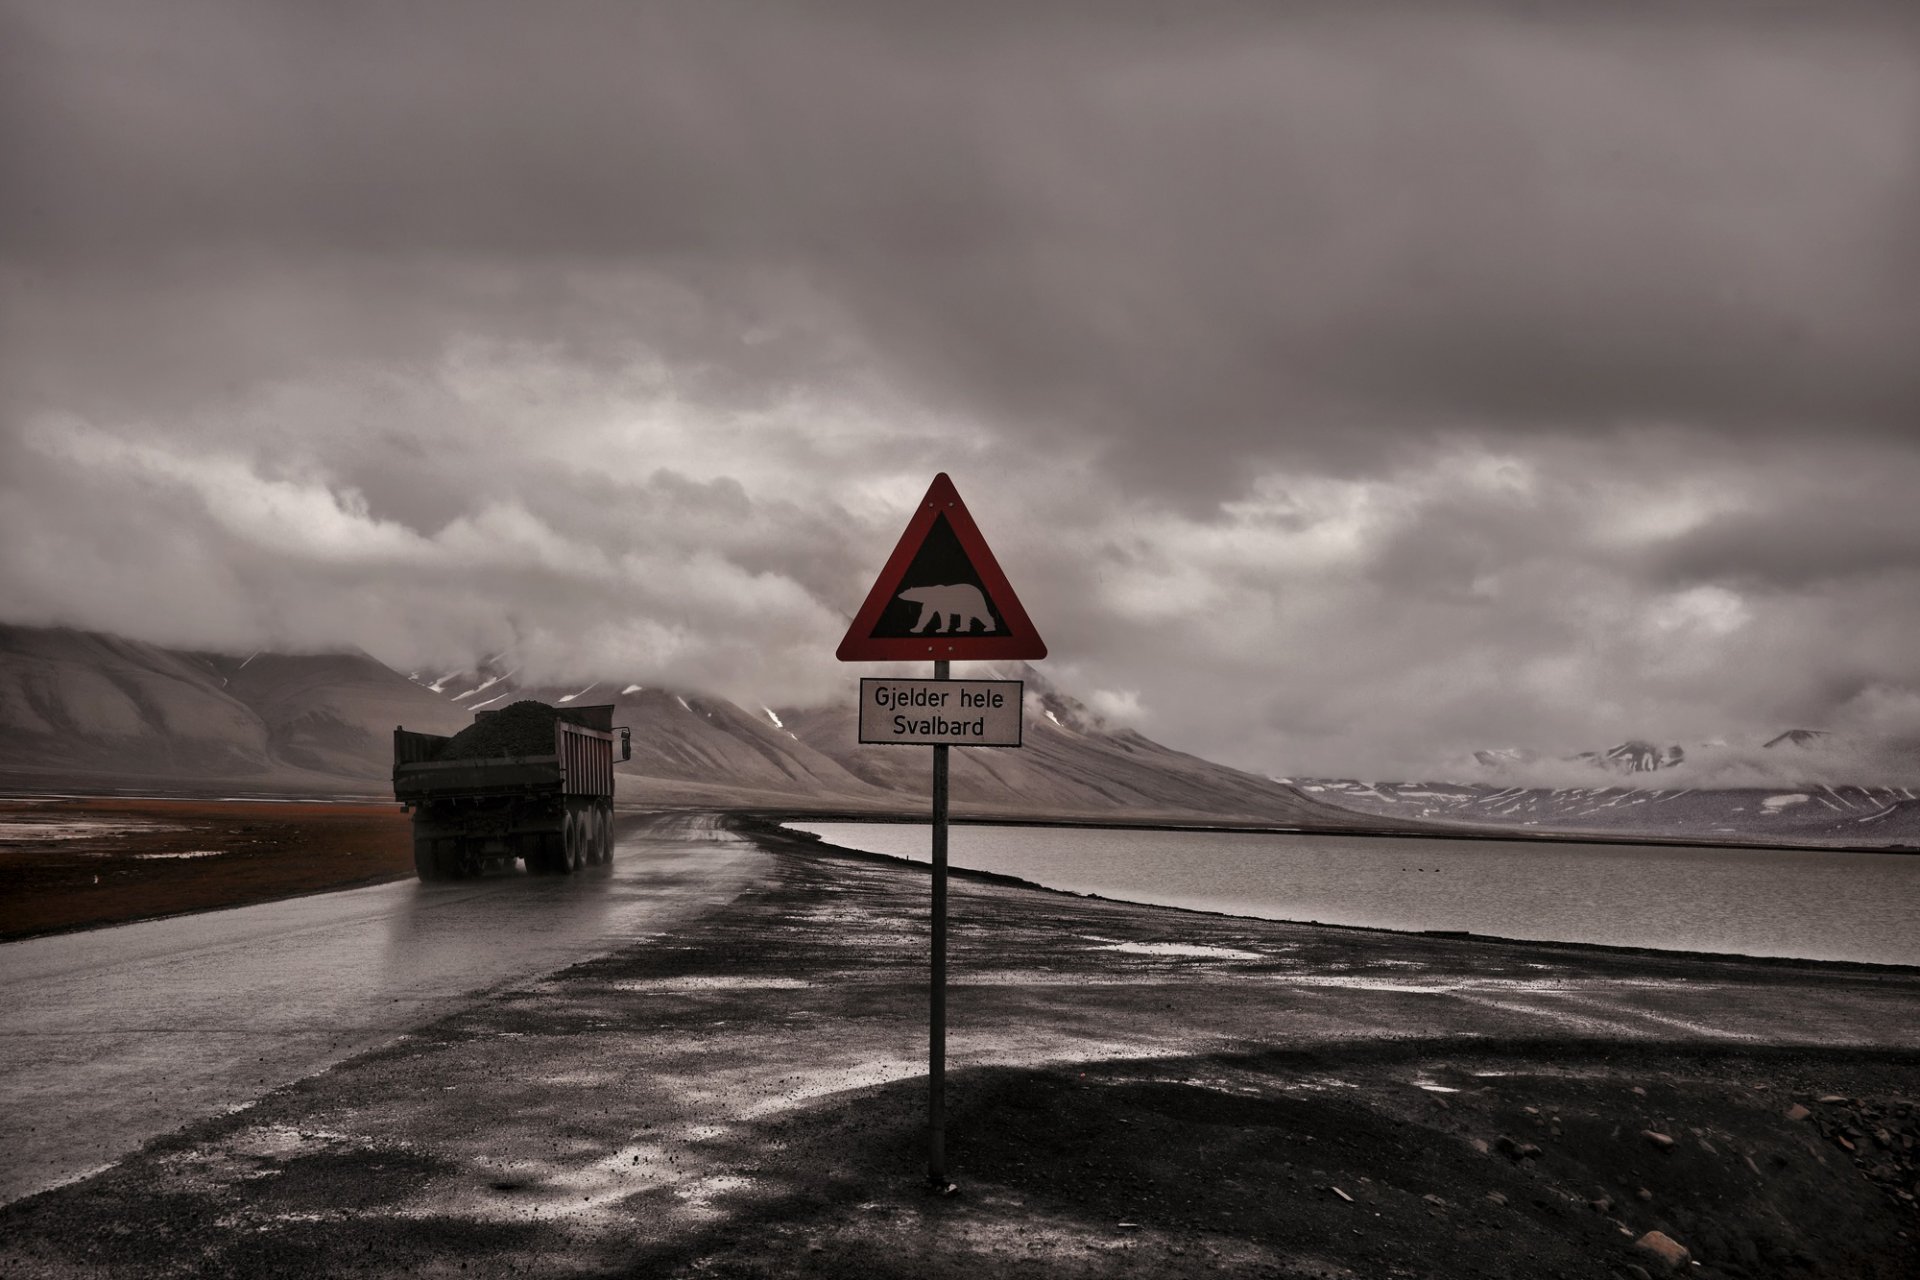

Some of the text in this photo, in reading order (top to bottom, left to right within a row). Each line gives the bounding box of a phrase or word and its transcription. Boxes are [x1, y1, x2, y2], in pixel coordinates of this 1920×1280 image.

[875, 687, 1004, 711] Gjelder hele
[893, 715, 984, 736] Svalbard
